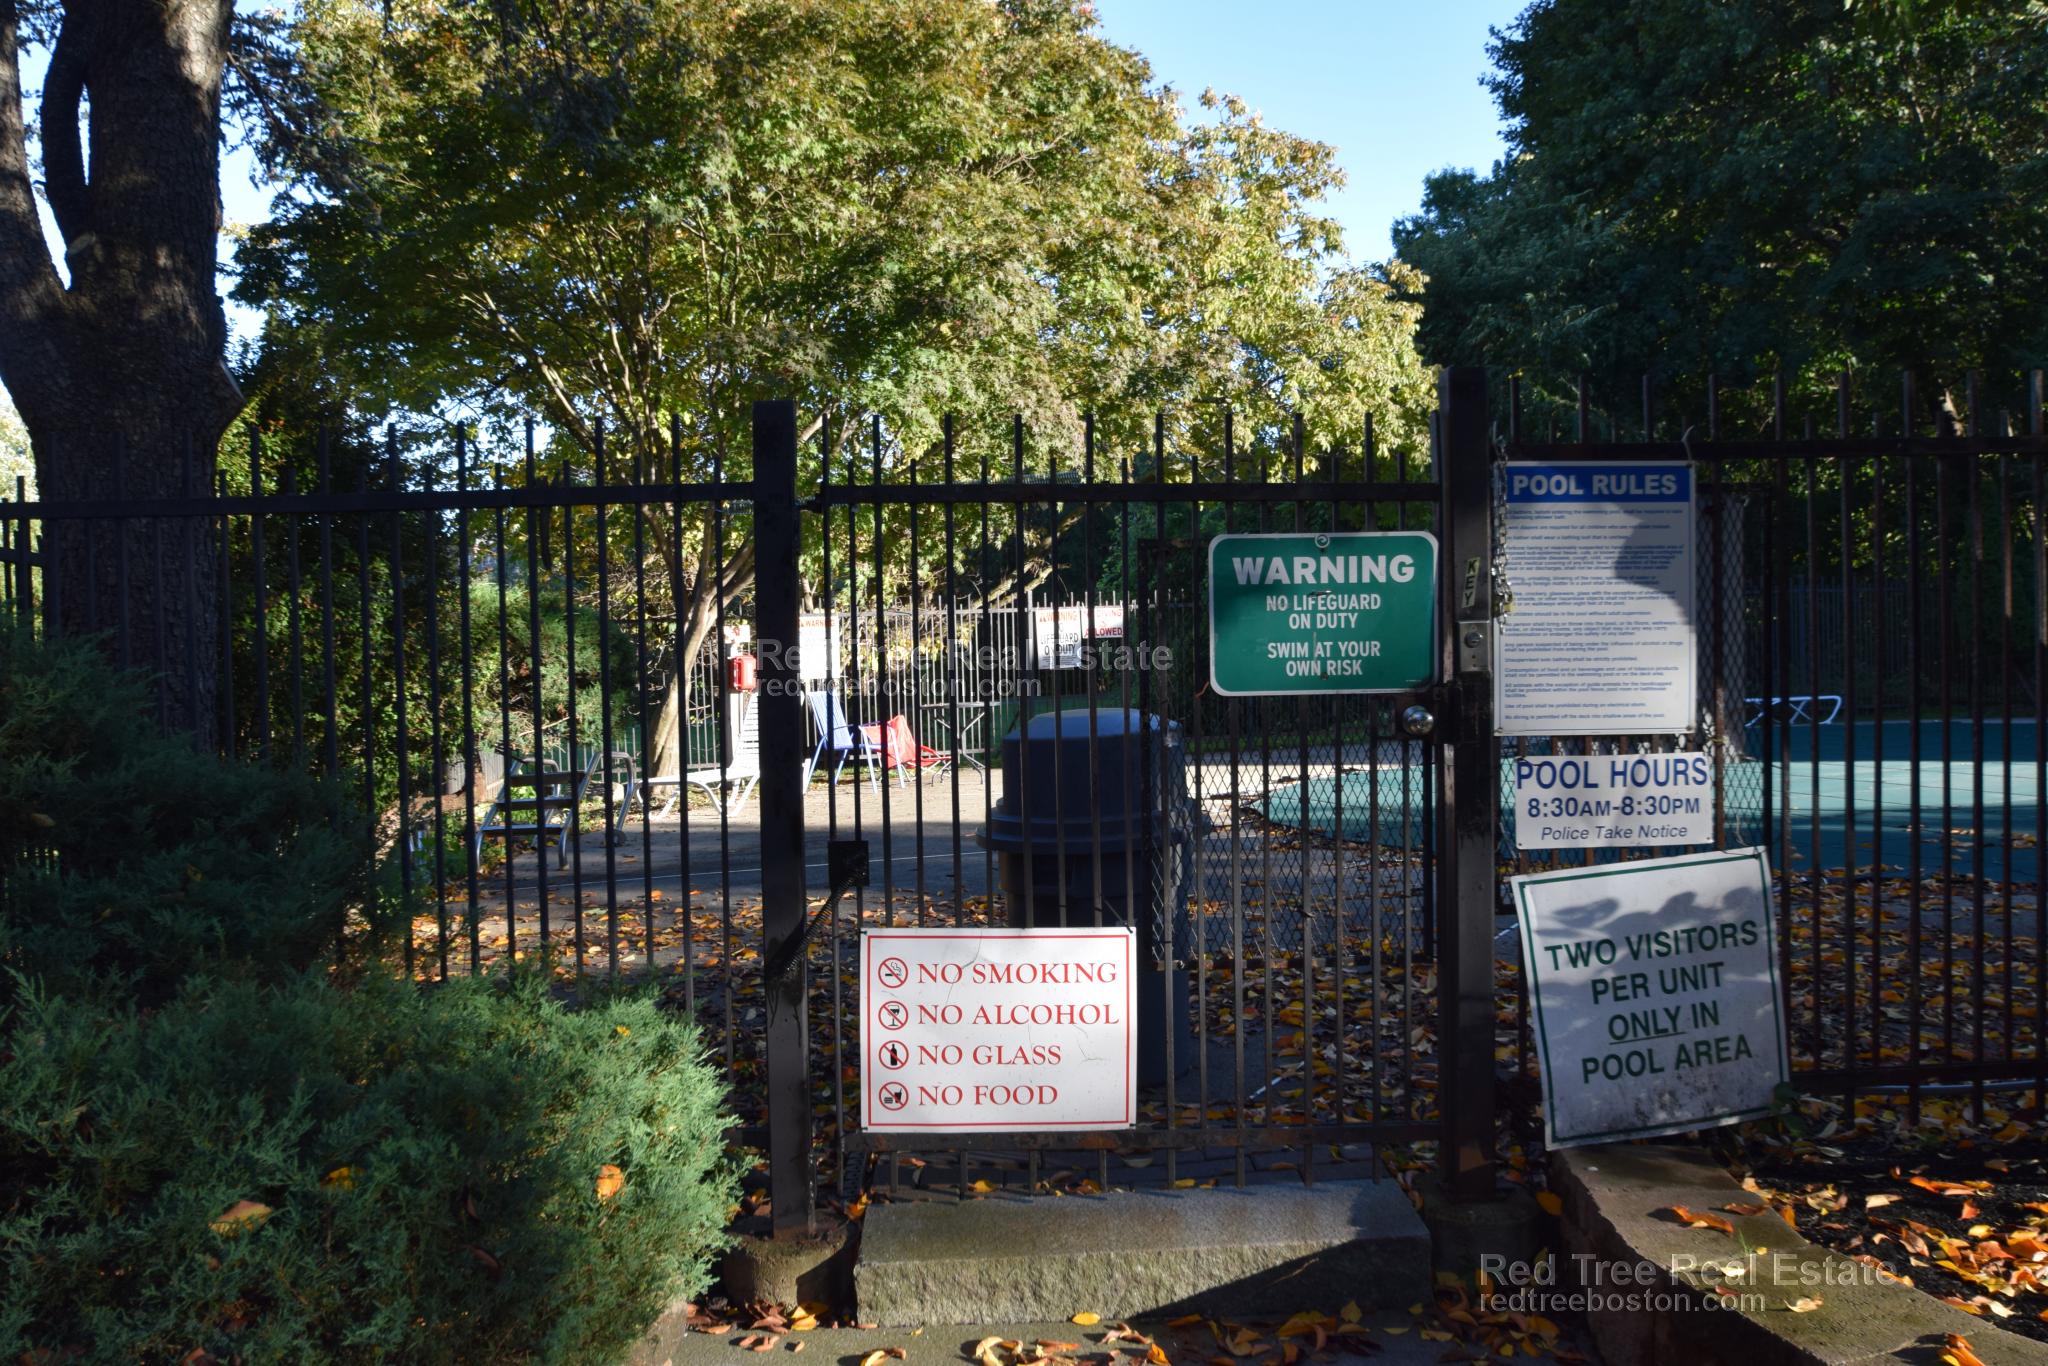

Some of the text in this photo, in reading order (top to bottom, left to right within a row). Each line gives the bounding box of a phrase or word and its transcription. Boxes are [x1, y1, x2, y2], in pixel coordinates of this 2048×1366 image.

[1513, 474, 1677, 495] POOL RULES
[1232, 554, 1415, 585] WARNING
[1464, 559, 1477, 606] KEY
[1267, 594, 1381, 611] NO LIFEGUARD
[1289, 613, 1358, 629] ON DUTY
[1040, 633, 1079, 646] LIFEUARD
[1084, 626, 1122, 638] ALOWED
[1267, 641, 1380, 659] SWIM AT YOUR
[1286, 659, 1363, 676] OWN RISK
[1516, 757, 1708, 789] POOL HOURS
[1528, 795, 1700, 818] 8:30AM-8:30PM
[1541, 825, 1688, 841] Police Take Notice
[1544, 920, 1758, 971] TWO VISITORS
[917, 962, 1117, 985] NO SMOKING
[1590, 961, 1724, 1005] PER UNIT
[917, 1004, 1120, 1025] NO ALCOHOL
[1608, 1000, 1720, 1042] ONLY IN
[917, 1044, 1062, 1066] NO GLASS
[1582, 1034, 1753, 1084] POOL AREA
[918, 1085, 1058, 1106] NO FOOD
